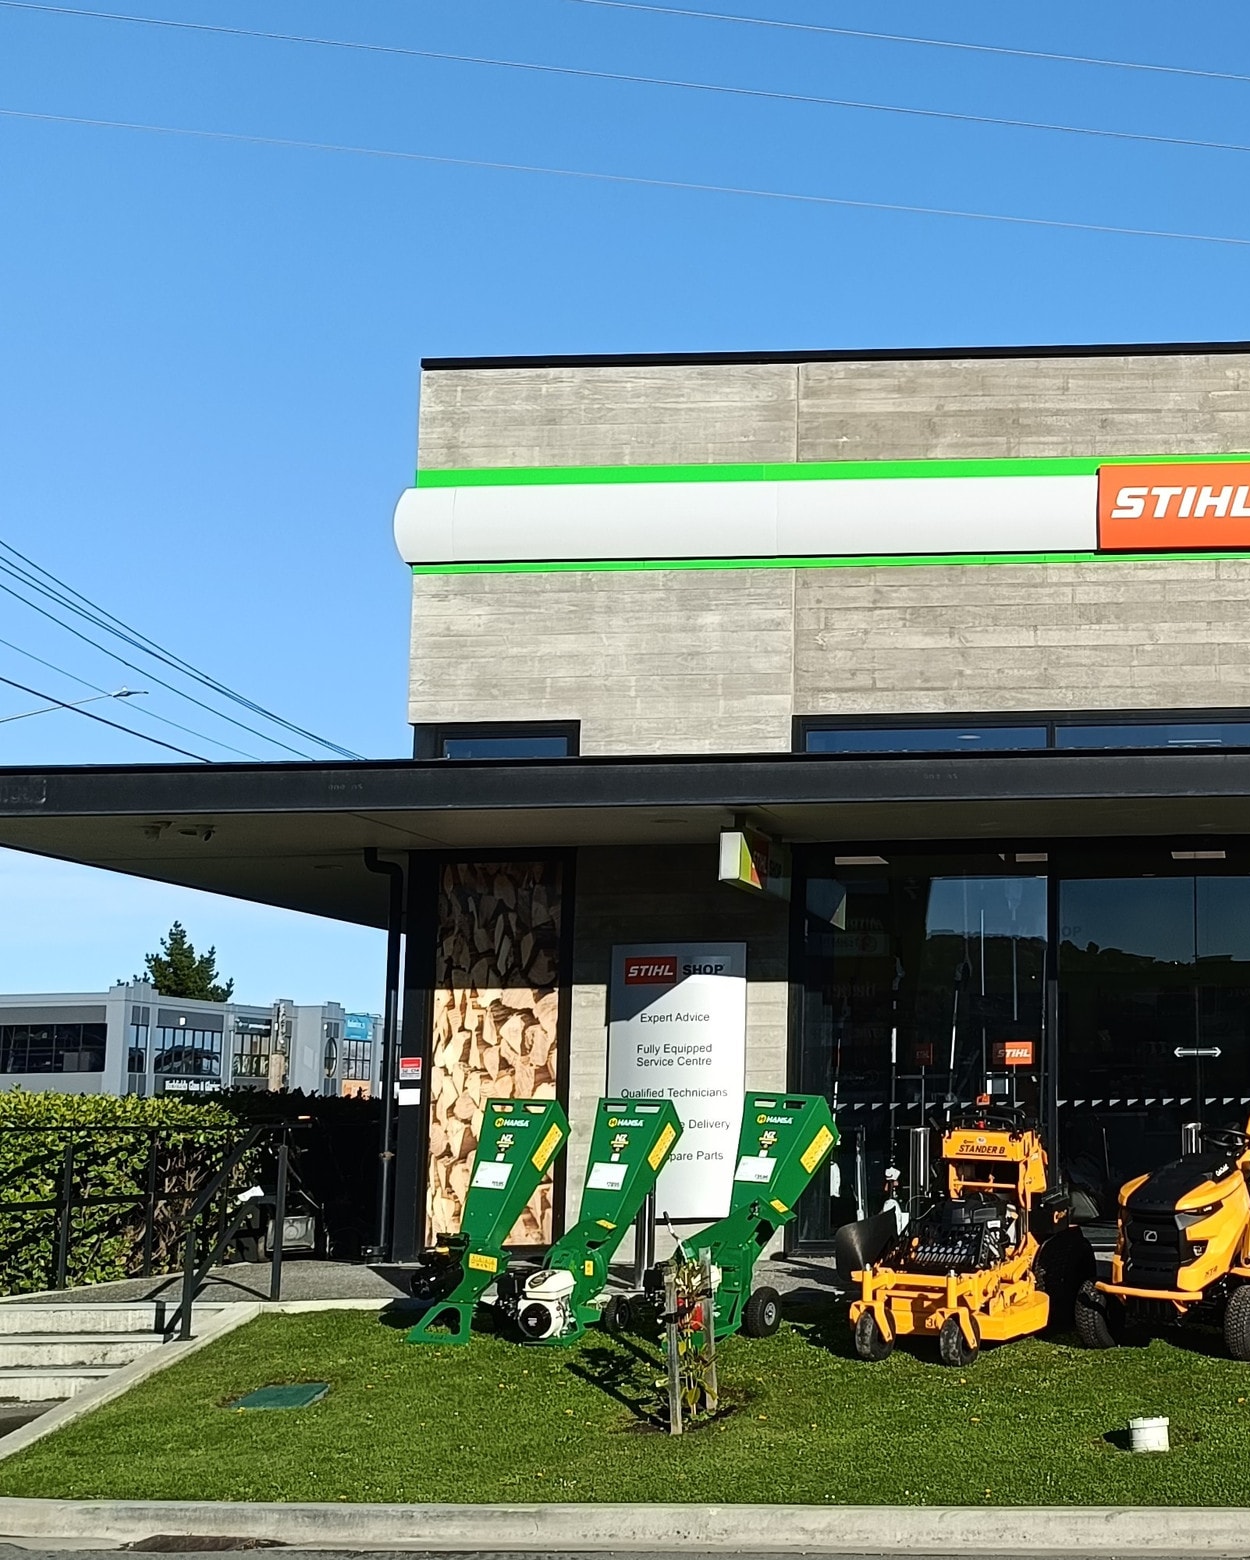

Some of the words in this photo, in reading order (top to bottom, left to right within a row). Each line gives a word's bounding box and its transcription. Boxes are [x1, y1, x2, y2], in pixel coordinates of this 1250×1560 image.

[628, 964, 674, 977] STIHL
[682, 963, 724, 976] SHOP
[640, 1012, 673, 1026] Expert
[675, 1012, 710, 1023] Advice
[637, 1043, 661, 1056] Fully
[663, 1043, 713, 1056] Equipped
[997, 1048, 1031, 1058] STIHL
[636, 1056, 674, 1067] Service
[677, 1056, 712, 1067] Centre
[620, 1087, 665, 1100] Qualified
[667, 1087, 728, 1098] Technicians
[503, 1118, 530, 1127] HANSA
[617, 1118, 645, 1127] HANSA
[688, 1119, 731, 1131] Delivery
[766, 1115, 794, 1125] HANSA
[958, 1144, 998, 1154] STANDER
[998, 1146, 1006, 1154] B
[669, 1152, 693, 1163] pare
[696, 1150, 724, 1161] Parts
